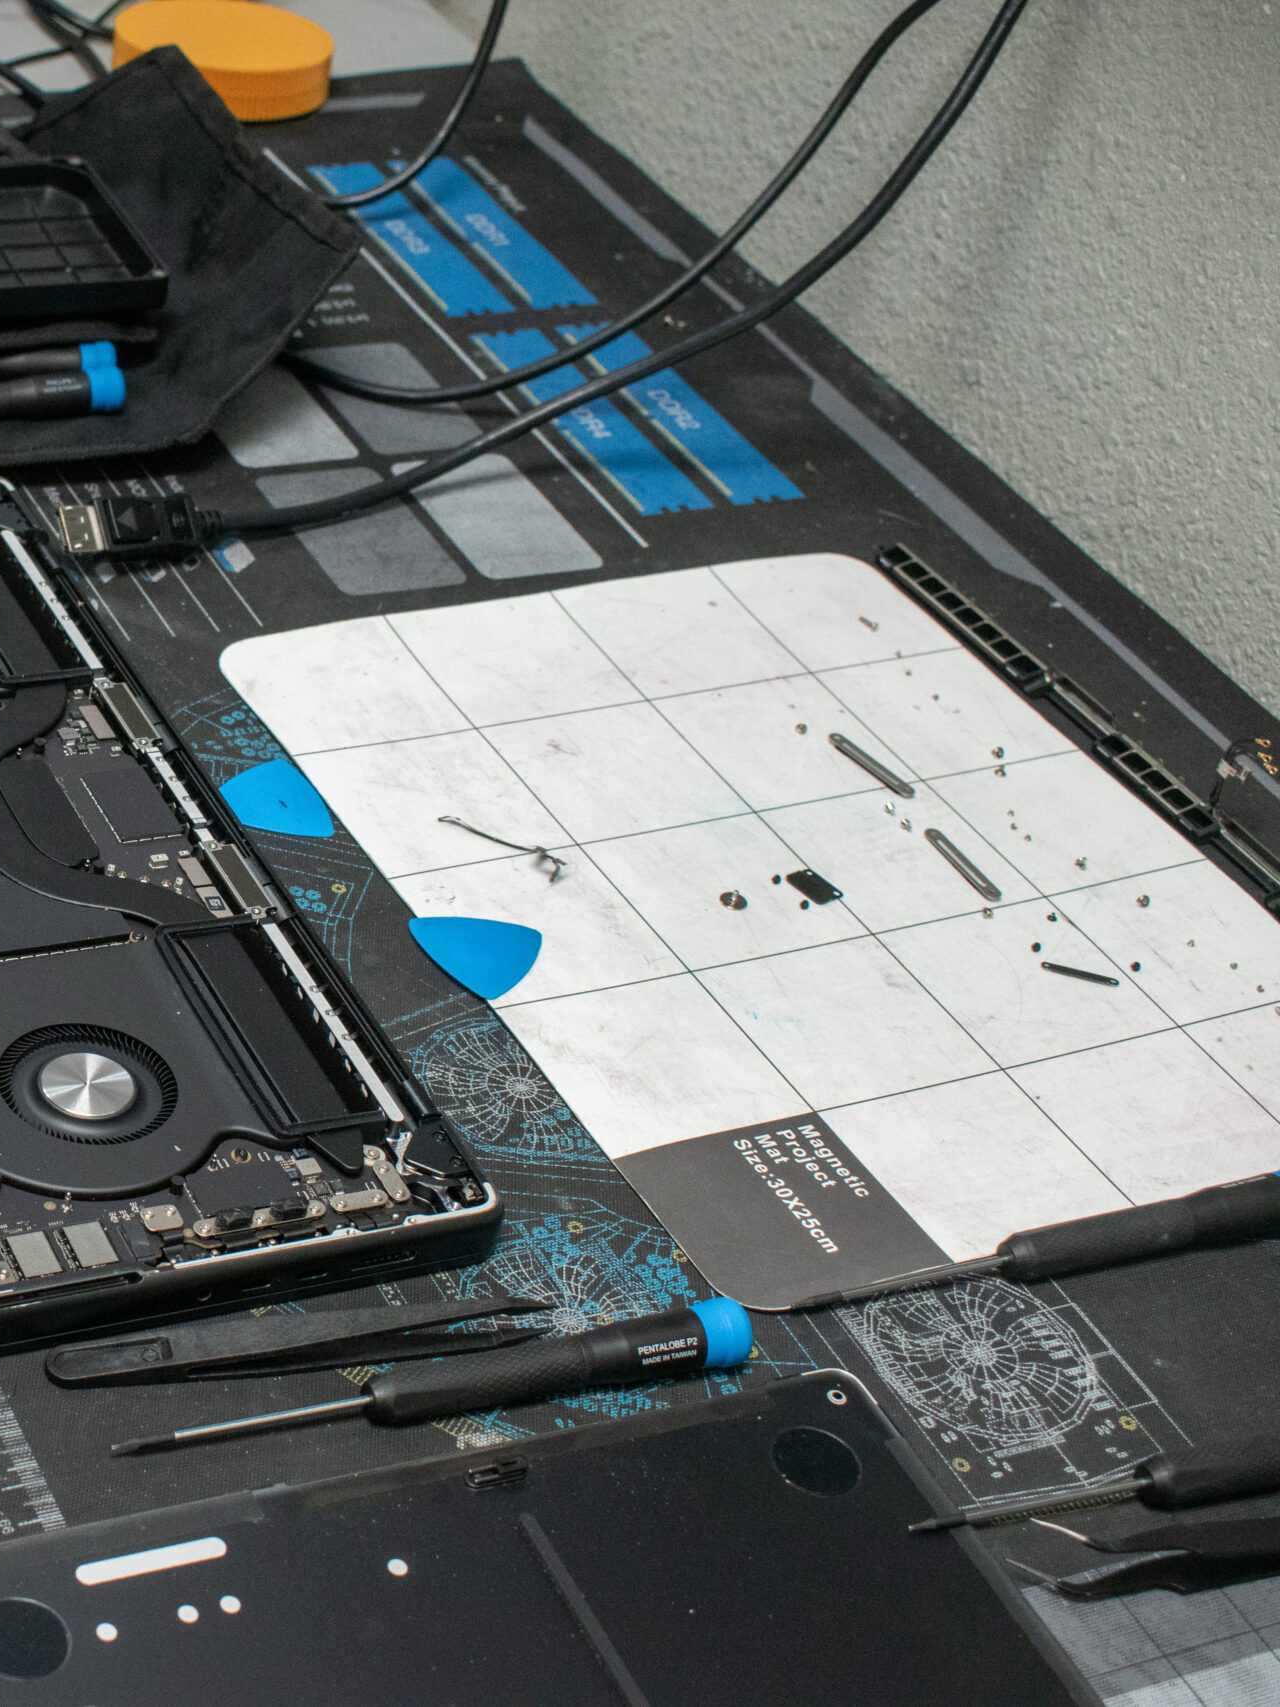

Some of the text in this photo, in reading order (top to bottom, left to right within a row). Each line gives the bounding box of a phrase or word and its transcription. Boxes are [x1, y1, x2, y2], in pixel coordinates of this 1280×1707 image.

[571, 406, 613, 439] DR4
[647, 388, 702, 431] DDR2
[753, 1133, 790, 1165] Mat
[775, 1128, 837, 1189] Project
[797, 1123, 870, 1198] Magnetic
[733, 1138, 839, 1254] Size:30X25cm
[637, 1336, 699, 1356] PENTALOBE P2
[641, 1355, 662, 1366] MADE
[670, 1348, 698, 1360] TAIWAN
